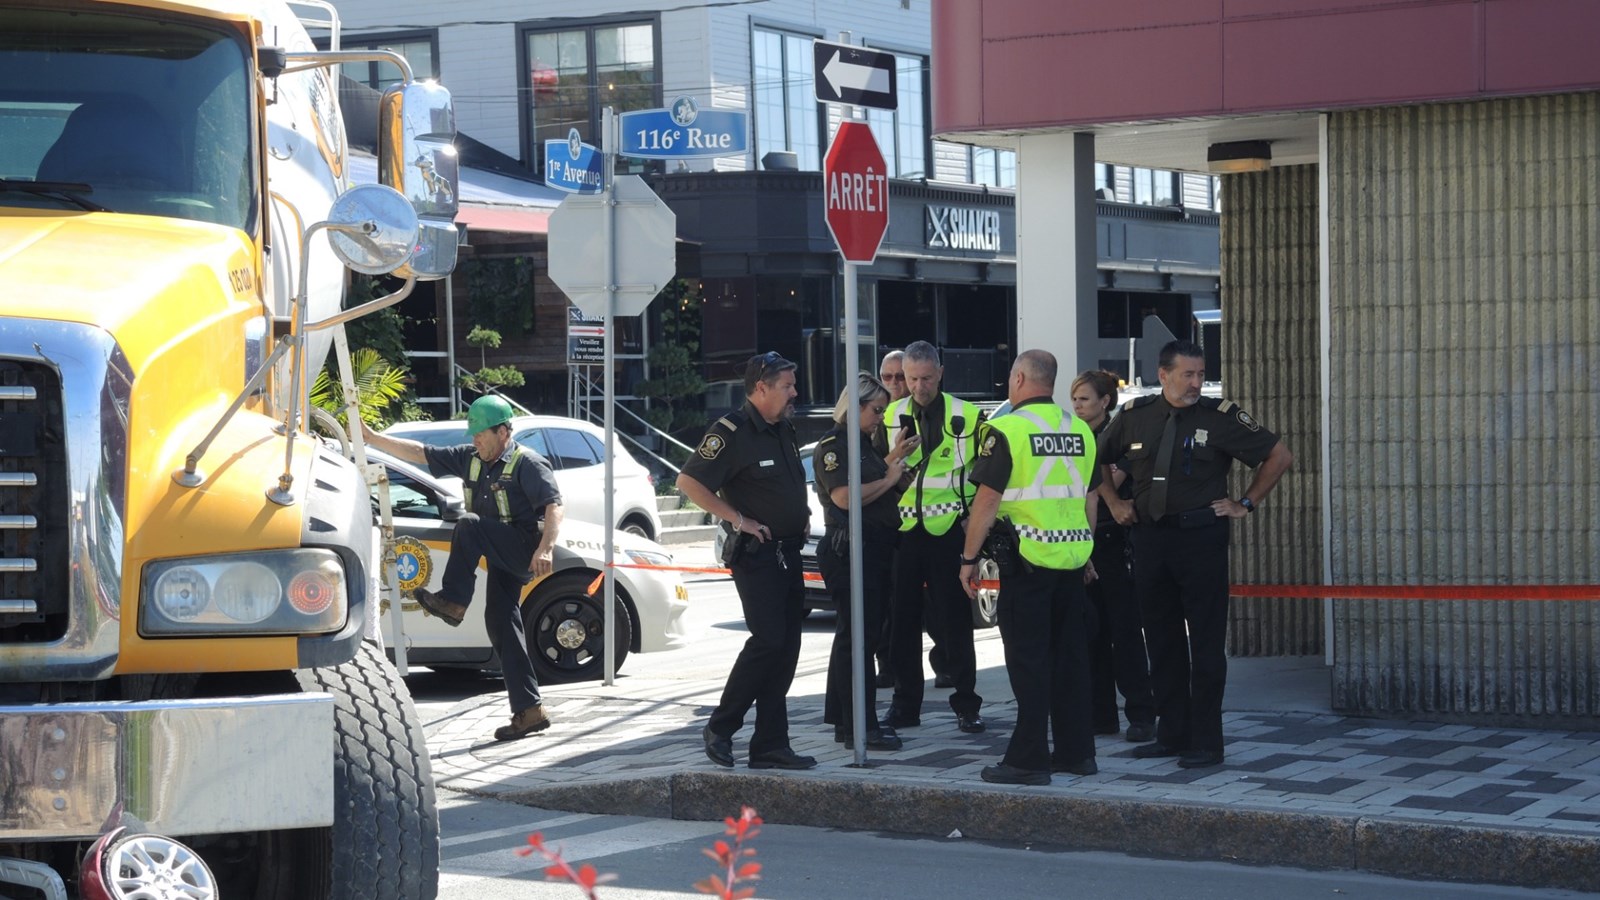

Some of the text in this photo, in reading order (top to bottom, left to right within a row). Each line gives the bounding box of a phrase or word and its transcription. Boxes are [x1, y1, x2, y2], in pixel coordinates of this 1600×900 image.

[686, 128, 732, 149] Rue
[563, 161, 601, 187] Avenue
[829, 166, 885, 212] ARRÊT
[949, 207, 1001, 252] SHAKER
[1033, 436, 1082, 454] POLICE
